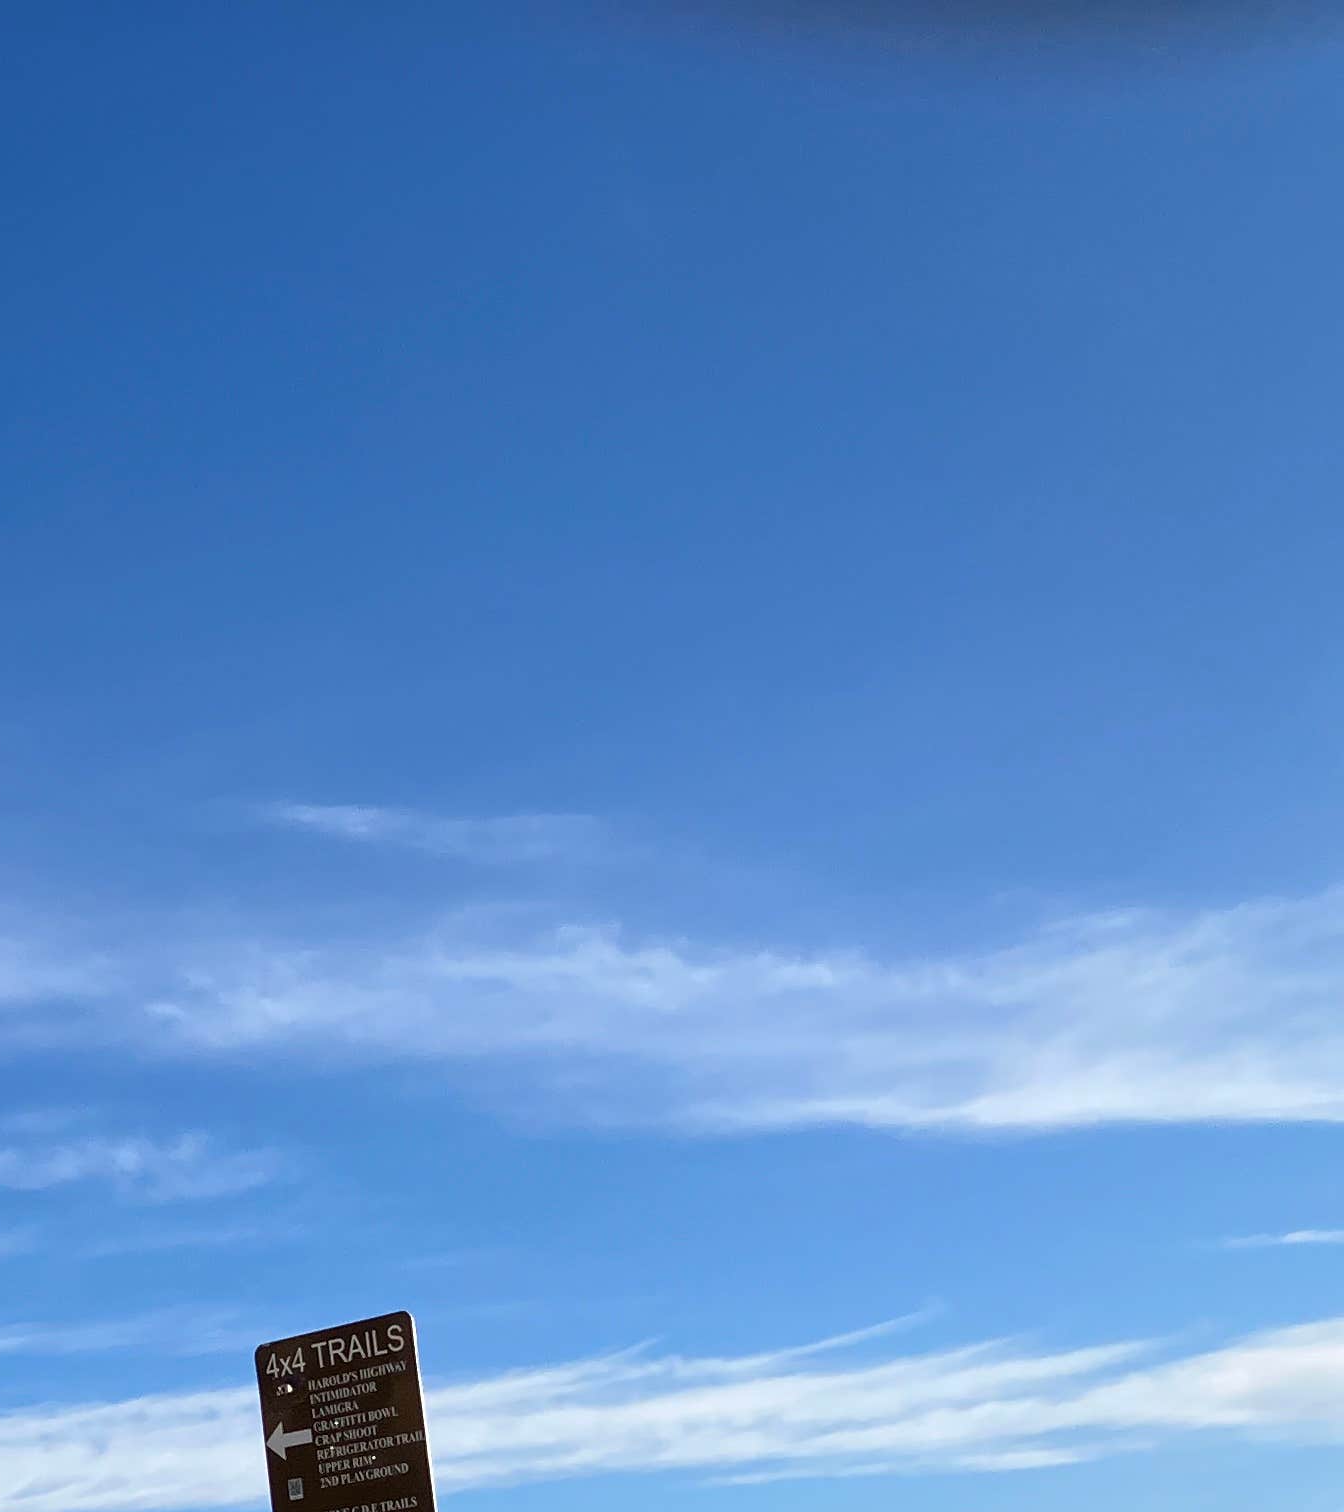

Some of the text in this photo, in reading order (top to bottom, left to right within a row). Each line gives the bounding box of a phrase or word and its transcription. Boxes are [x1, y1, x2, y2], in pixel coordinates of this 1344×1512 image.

[266, 1324, 405, 1378] 4x4 TRAILS
[307, 1360, 407, 1391] HAROLD'S HIGHWAY
[309, 1381, 378, 1404] INTIMIDATOR
[368, 1406, 399, 1421] BOWL
[342, 1425, 378, 1441] SHOOT
[316, 1429, 425, 1461] REFRIGERATOR TRAIL
[318, 1455, 373, 1475] UPPER RIM
[320, 1462, 409, 1489] 2ND PLAYGROUND
[378, 1496, 418, 1512] TRAILS
